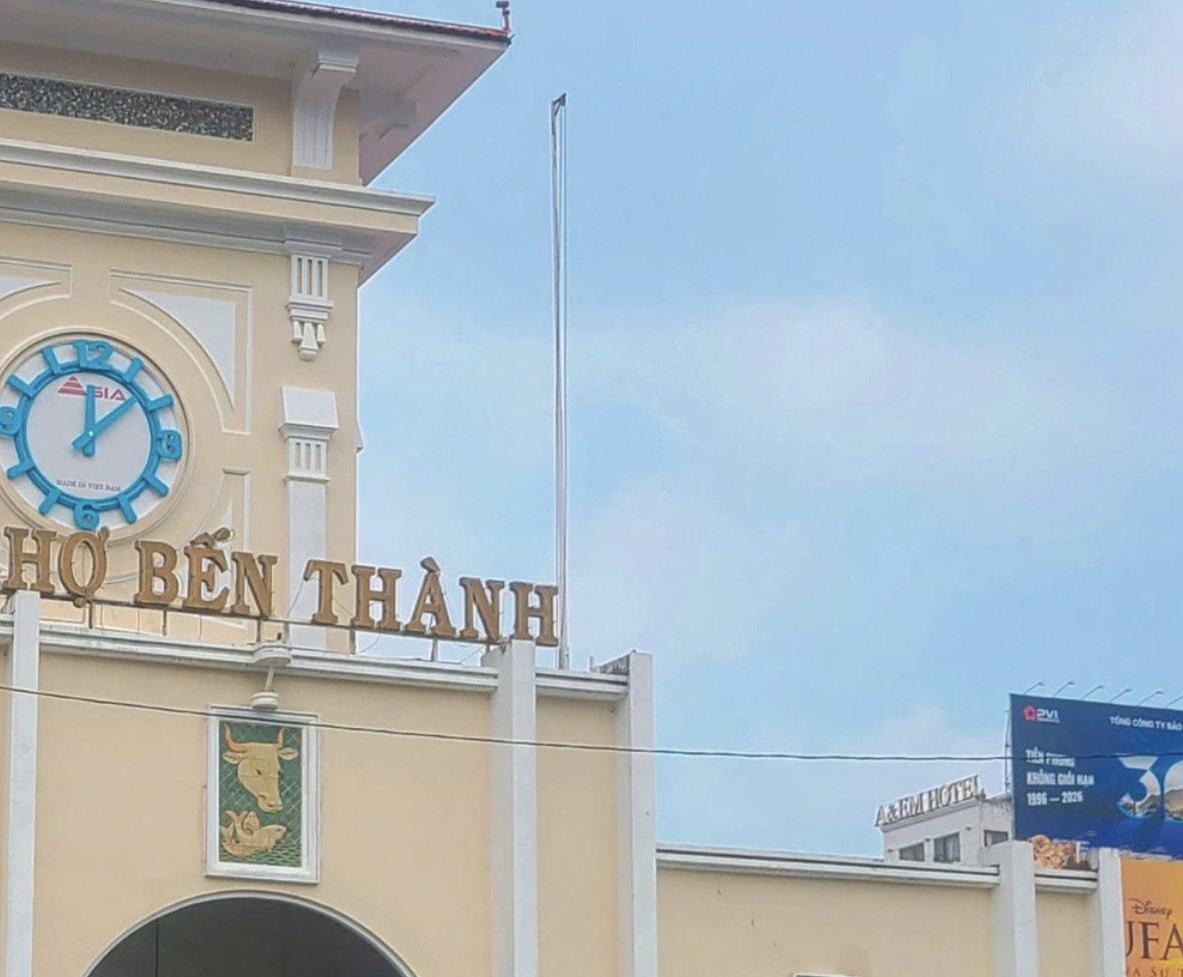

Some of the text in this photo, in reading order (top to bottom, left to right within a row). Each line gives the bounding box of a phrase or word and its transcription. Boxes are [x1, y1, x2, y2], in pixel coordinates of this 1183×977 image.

[72, 339, 114, 371] 12
[73, 502, 99, 531] 6
[133, 526, 277, 618] BẾN
[304, 556, 559, 646] THÀNH
[1155, 720, 1166, 729] TY
